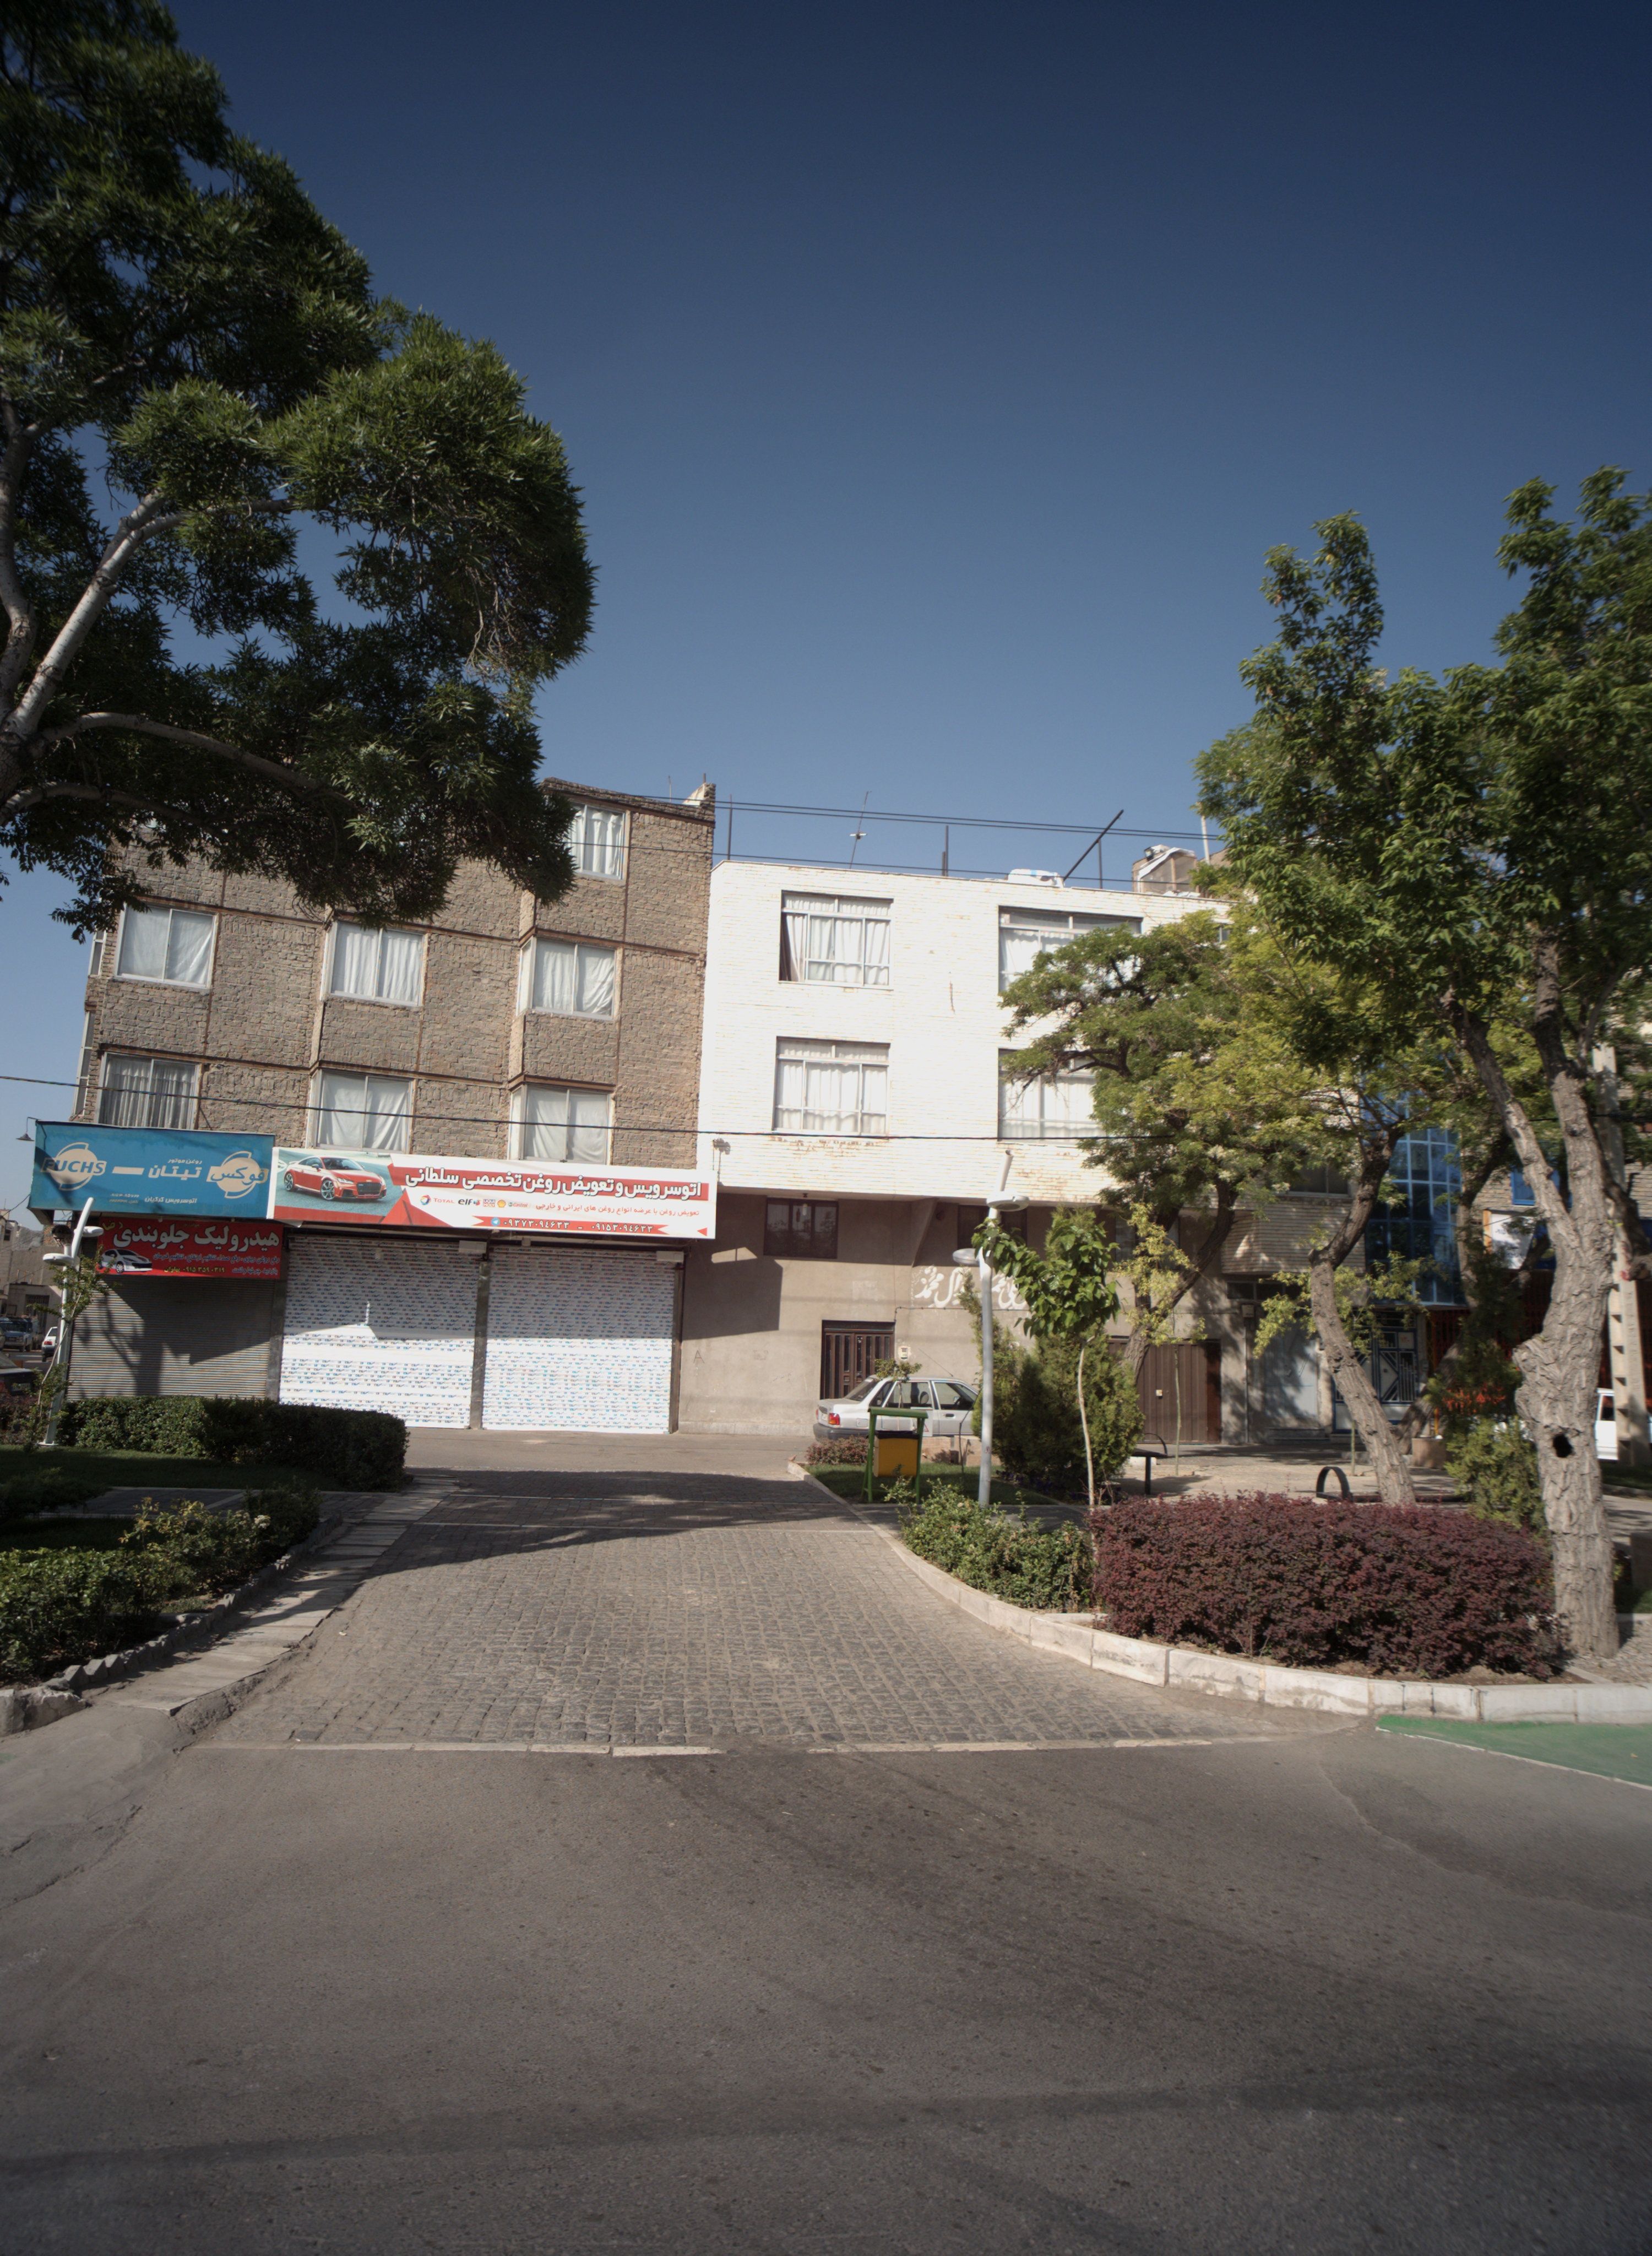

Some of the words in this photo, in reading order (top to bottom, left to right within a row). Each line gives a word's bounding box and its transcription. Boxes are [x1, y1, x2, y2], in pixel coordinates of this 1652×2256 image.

[44, 1158, 105, 1174] FUCHS
[148, 1165, 203, 1181] تیتان
[405, 1167, 460, 1187] سلطانی
[462, 1170, 523, 1190] تخصصی
[523, 1173, 562, 1194] روغن
[562, 1175, 615, 1196] تعویض
[615, 1181, 624, 1198] و
[624, 1181, 702, 1201] اتوسرویس
[616, 1207, 632, 1215] انواع
[113, 1223, 190, 1249] جلوبندی
[194, 1225, 280, 1252] هیدرولیک
